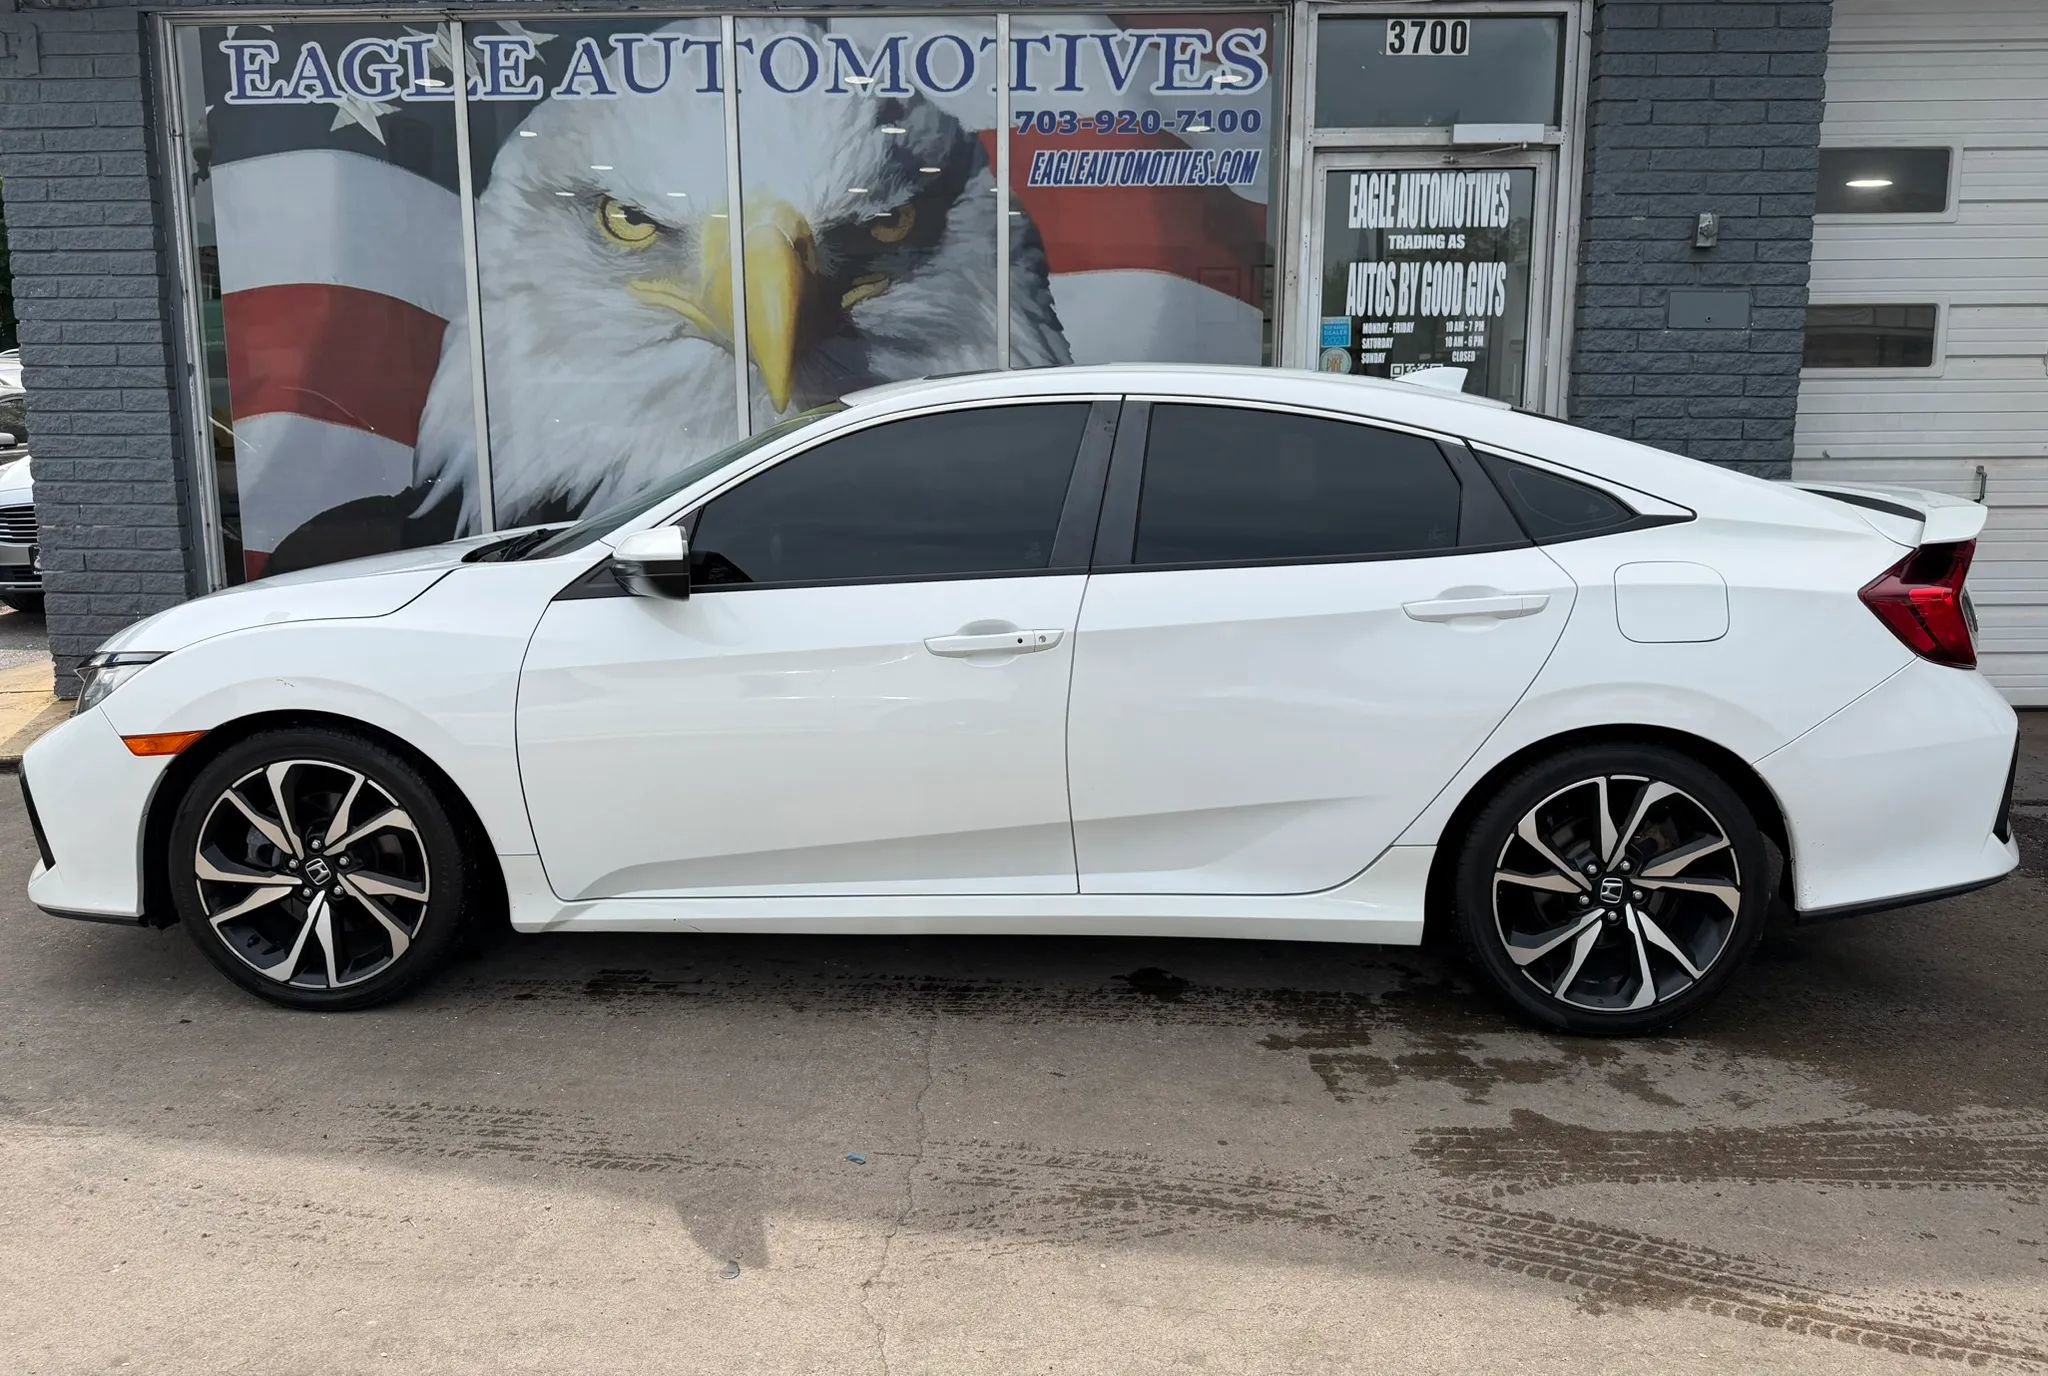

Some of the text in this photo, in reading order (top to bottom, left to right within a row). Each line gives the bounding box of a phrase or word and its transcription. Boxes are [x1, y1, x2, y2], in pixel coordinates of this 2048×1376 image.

[1389, 20, 1467, 54] 3700
[221, 28, 1267, 103] EAGLE AUTOMOTIVES
[1015, 109, 1262, 135] 703-920-7100
[1027, 148, 1262, 187] EAGLEAUTOMOTIVES.COM
[1349, 172, 1510, 228] EAGLE AUTOMOTIVES
[1388, 234, 1466, 249] TRADING AS
[1346, 261, 1506, 317] AUTOS BY GOOD GUYS
[1362, 322, 1388, 334] MONDAY
[1392, 321, 1415, 333] FRIDAY
[1446, 321, 1453, 332] 10
[1454, 321, 1464, 332] AM
[1468, 320, 1473, 332] 7
[1474, 321, 1485, 332] PM
[1361, 337, 1393, 349] SATURDAY
[1445, 336, 1452, 348] 10
[1453, 336, 1463, 347] AM
[1473, 336, 1483, 347] PM
[1361, 352, 1386, 364] SUNDAY
[1452, 350, 1475, 362] CLOSED
